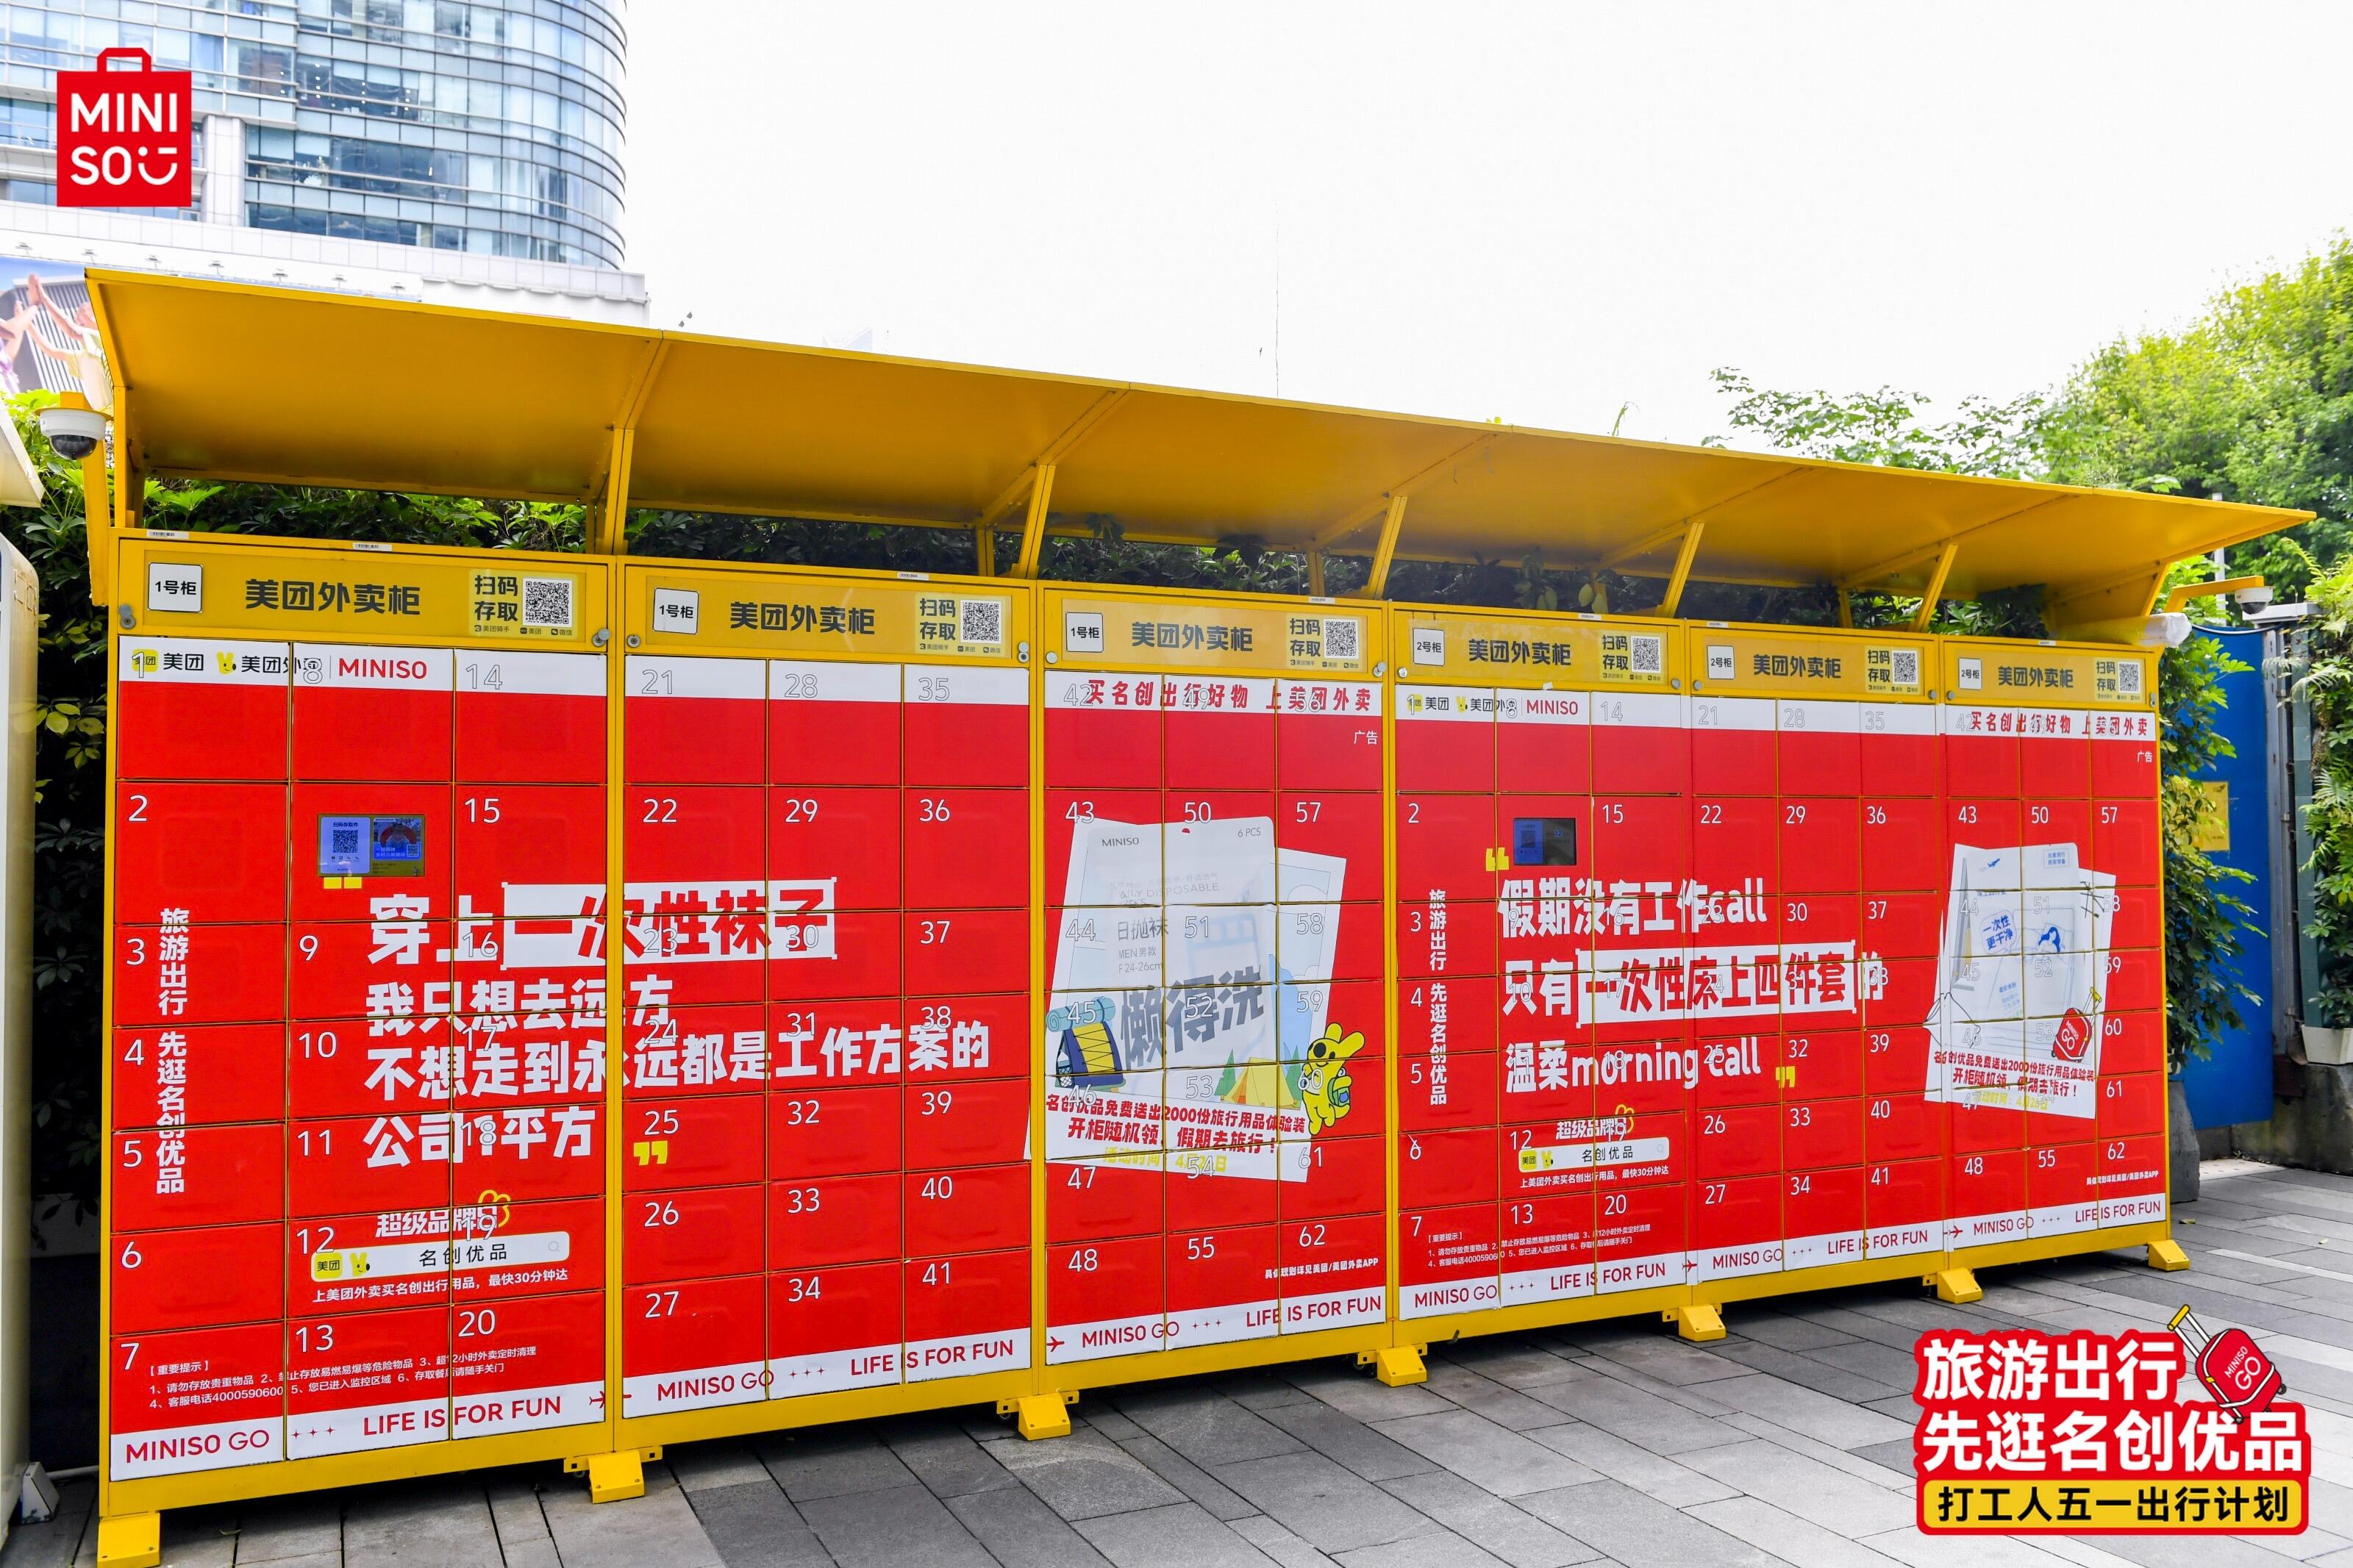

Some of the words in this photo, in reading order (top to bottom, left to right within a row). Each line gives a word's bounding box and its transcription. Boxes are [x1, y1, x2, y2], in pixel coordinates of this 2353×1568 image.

[155, 580, 196, 595] 1号柜
[475, 575, 518, 596] 扫码
[246, 579, 421, 615] 美团外卖柜
[474, 601, 518, 621] 存取
[659, 604, 693, 619] 1号柜
[730, 601, 875, 634] 美团外卖柜
[920, 598, 955, 617] 扫码
[920, 622, 956, 640] 存取
[1071, 626, 1099, 639] 1号柜
[1132, 621, 1252, 651] 美团外卖柜
[1290, 618, 1320, 636] 扫码
[1290, 640, 1321, 656] 存取
[1417, 642, 1441, 653] 2号柜
[1469, 639, 1571, 666] 美团外卖柜
[1602, 635, 1627, 651] 扫码
[163, 653, 204, 670] 美团
[1603, 654, 1628, 670] 存取
[1711, 657, 1732, 667] 2号柜
[1754, 654, 1841, 679] 美团外卖柜
[1868, 650, 1890, 665] 扫码
[338, 658, 427, 679] MINISO
[1868, 667, 1890, 683] 存取
[1962, 669, 1979, 679] 2号柜
[1999, 666, 2074, 688] 美团外卖柜
[2096, 661, 2115, 675] 扫码
[642, 670, 674, 694] 21
[2097, 678, 2115, 692] 存取
[1426, 697, 1449, 711] 美团
[1527, 700, 1578, 715] MINISO
[1354, 731, 1378, 745] 广告
[2138, 751, 2152, 763] 广告
[128, 795, 148, 822] 2
[464, 798, 500, 823] 15
[642, 799, 678, 823] 22
[919, 800, 951, 823] 36
[1065, 802, 1094, 824] 43
[1296, 802, 1321, 823] 57
[1408, 803, 1419, 823] 2
[1602, 805, 1624, 824] 15
[1700, 806, 1722, 824] 22
[1958, 806, 1977, 823] 43
[2102, 807, 2118, 823] 57
[1102, 837, 1139, 847] MINISO
[1238, 829, 1243, 837] 6
[1245, 827, 1261, 837] PCS
[1787, 903, 1807, 922] 30
[1429, 889, 1446, 971] 旅游出行
[1982, 914, 2010, 932] 一次性
[299, 934, 319, 962] 9
[1987, 928, 2013, 950] 更干净
[158, 908, 190, 1016] 旅游出行
[1121, 964, 1264, 1070] 懒得洗
[1429, 983, 1448, 1105] 先逛名创优品
[2062, 1028, 2074, 1050] GO
[2107, 1081, 2123, 1098] 61
[156, 1031, 187, 1194] 先逛名创优品
[1871, 1100, 1890, 1118] 40
[1522, 1156, 1535, 1164] 美团
[1582, 1146, 1633, 1162] 名创优品
[2107, 1142, 2125, 1160] 62
[1965, 1158, 1983, 1175] 48
[1705, 1184, 1725, 1204] 27
[1974, 1220, 2013, 1235] MINISO
[2017, 1217, 2034, 1229] GO
[2076, 1209, 2097, 1222] LIFE
[2102, 1207, 2110, 1219] IS
[2114, 1204, 2135, 1217] FOR
[2139, 1200, 2160, 1214] FUN
[1299, 1225, 1326, 1247] 62
[419, 1244, 507, 1267] 名创优品
[1713, 1251, 1759, 1269] MINISO
[1763, 1249, 1783, 1263] GO
[1828, 1239, 1854, 1254] LIFE
[1859, 1237, 1869, 1250] IS
[1874, 1234, 1898, 1248] FOR
[1902, 1230, 1928, 1245] FUN
[317, 1260, 340, 1271] 美团
[1068, 1249, 1098, 1272] 48
[922, 1262, 951, 1286] 41
[1415, 1288, 1469, 1308] MINISO
[1474, 1285, 1497, 1300] GO
[1551, 1273, 1580, 1290] LIFE
[1586, 1271, 1597, 1285] IS
[1604, 1267, 1631, 1284] FOR
[1637, 1263, 1665, 1279] FUN
[458, 1310, 496, 1337] 20
[1082, 1325, 1146, 1347] MINISO
[1151, 1322, 1179, 1339] GO
[1246, 1308, 1280, 1328] LIFE
[1288, 1306, 1302, 1322] IS
[1308, 1301, 1341, 1319] FOR
[1347, 1296, 1381, 1314] FUN
[121, 1342, 140, 1370] 7
[657, 1375, 735, 1401] MINISO
[741, 1370, 774, 1389] GO
[851, 1355, 893, 1376] LIFE
[926, 1345, 965, 1366] FOR
[973, 1340, 1013, 1361] FUN
[126, 1435, 221, 1464] MINISO
[229, 1430, 269, 1452] GO
[363, 1411, 415, 1436] LIFE
[424, 1408, 445, 1428] IS
[454, 1403, 502, 1426] FOR
[511, 1396, 561, 1419] FUN
